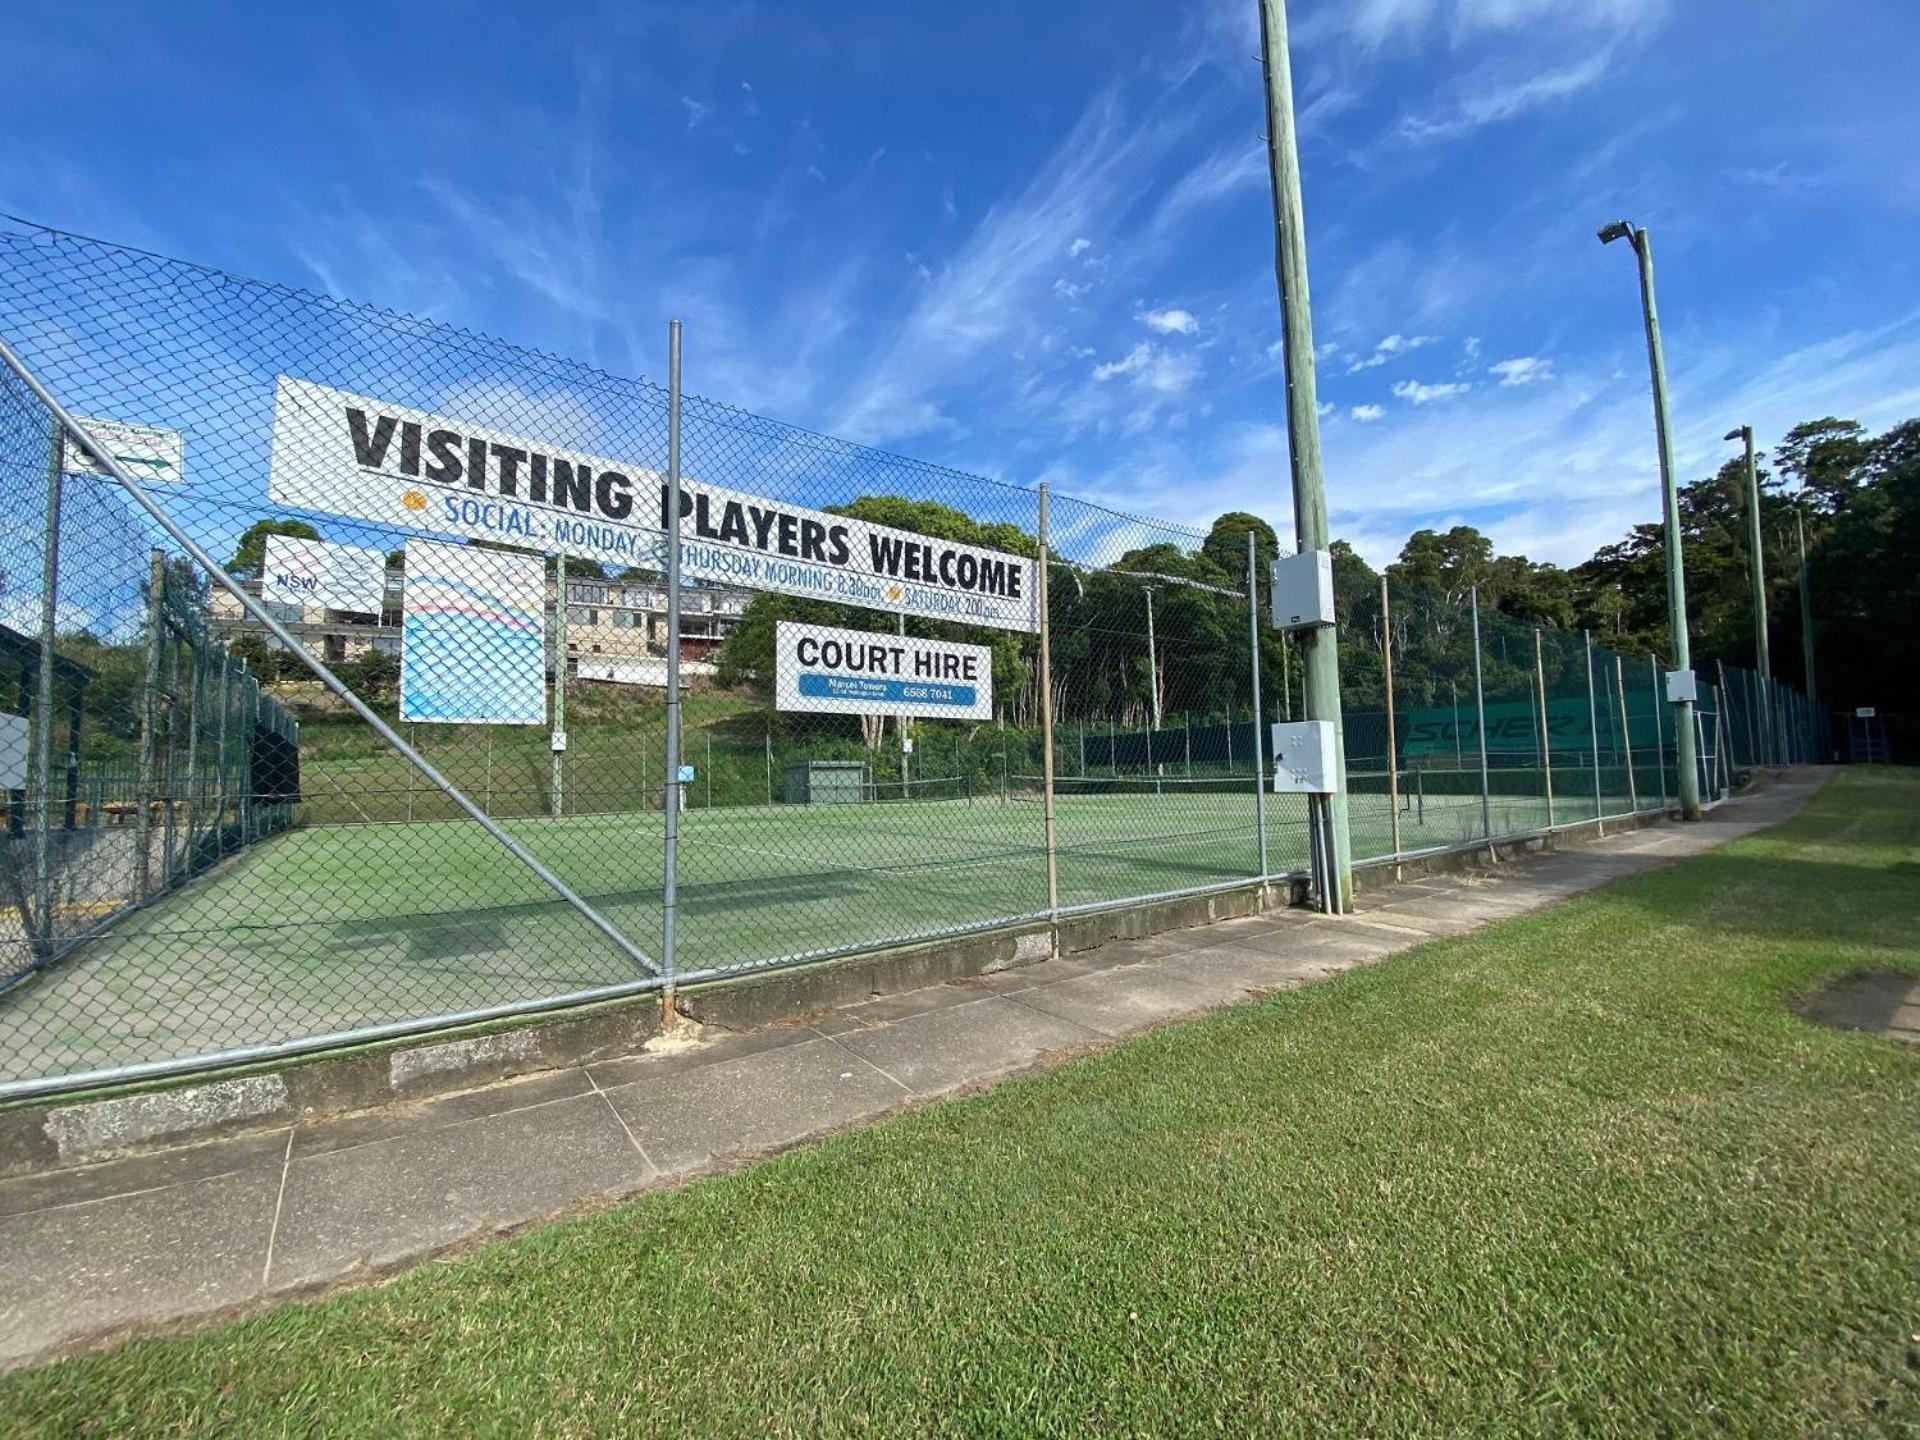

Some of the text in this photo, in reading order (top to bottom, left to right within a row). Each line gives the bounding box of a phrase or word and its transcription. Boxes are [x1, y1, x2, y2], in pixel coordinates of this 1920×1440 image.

[345, 406, 1022, 599] VISITING PLAYERS WELCOME
[443, 496, 546, 540] SOCIAL:
[554, 518, 639, 554] MONDAY
[765, 560, 833, 591] MORNING
[904, 587, 963, 614] SATURDAY
[276, 573, 318, 591] NSW
[796, 637, 978, 681] COURT HIRE
[929, 688, 953, 700] 7041
